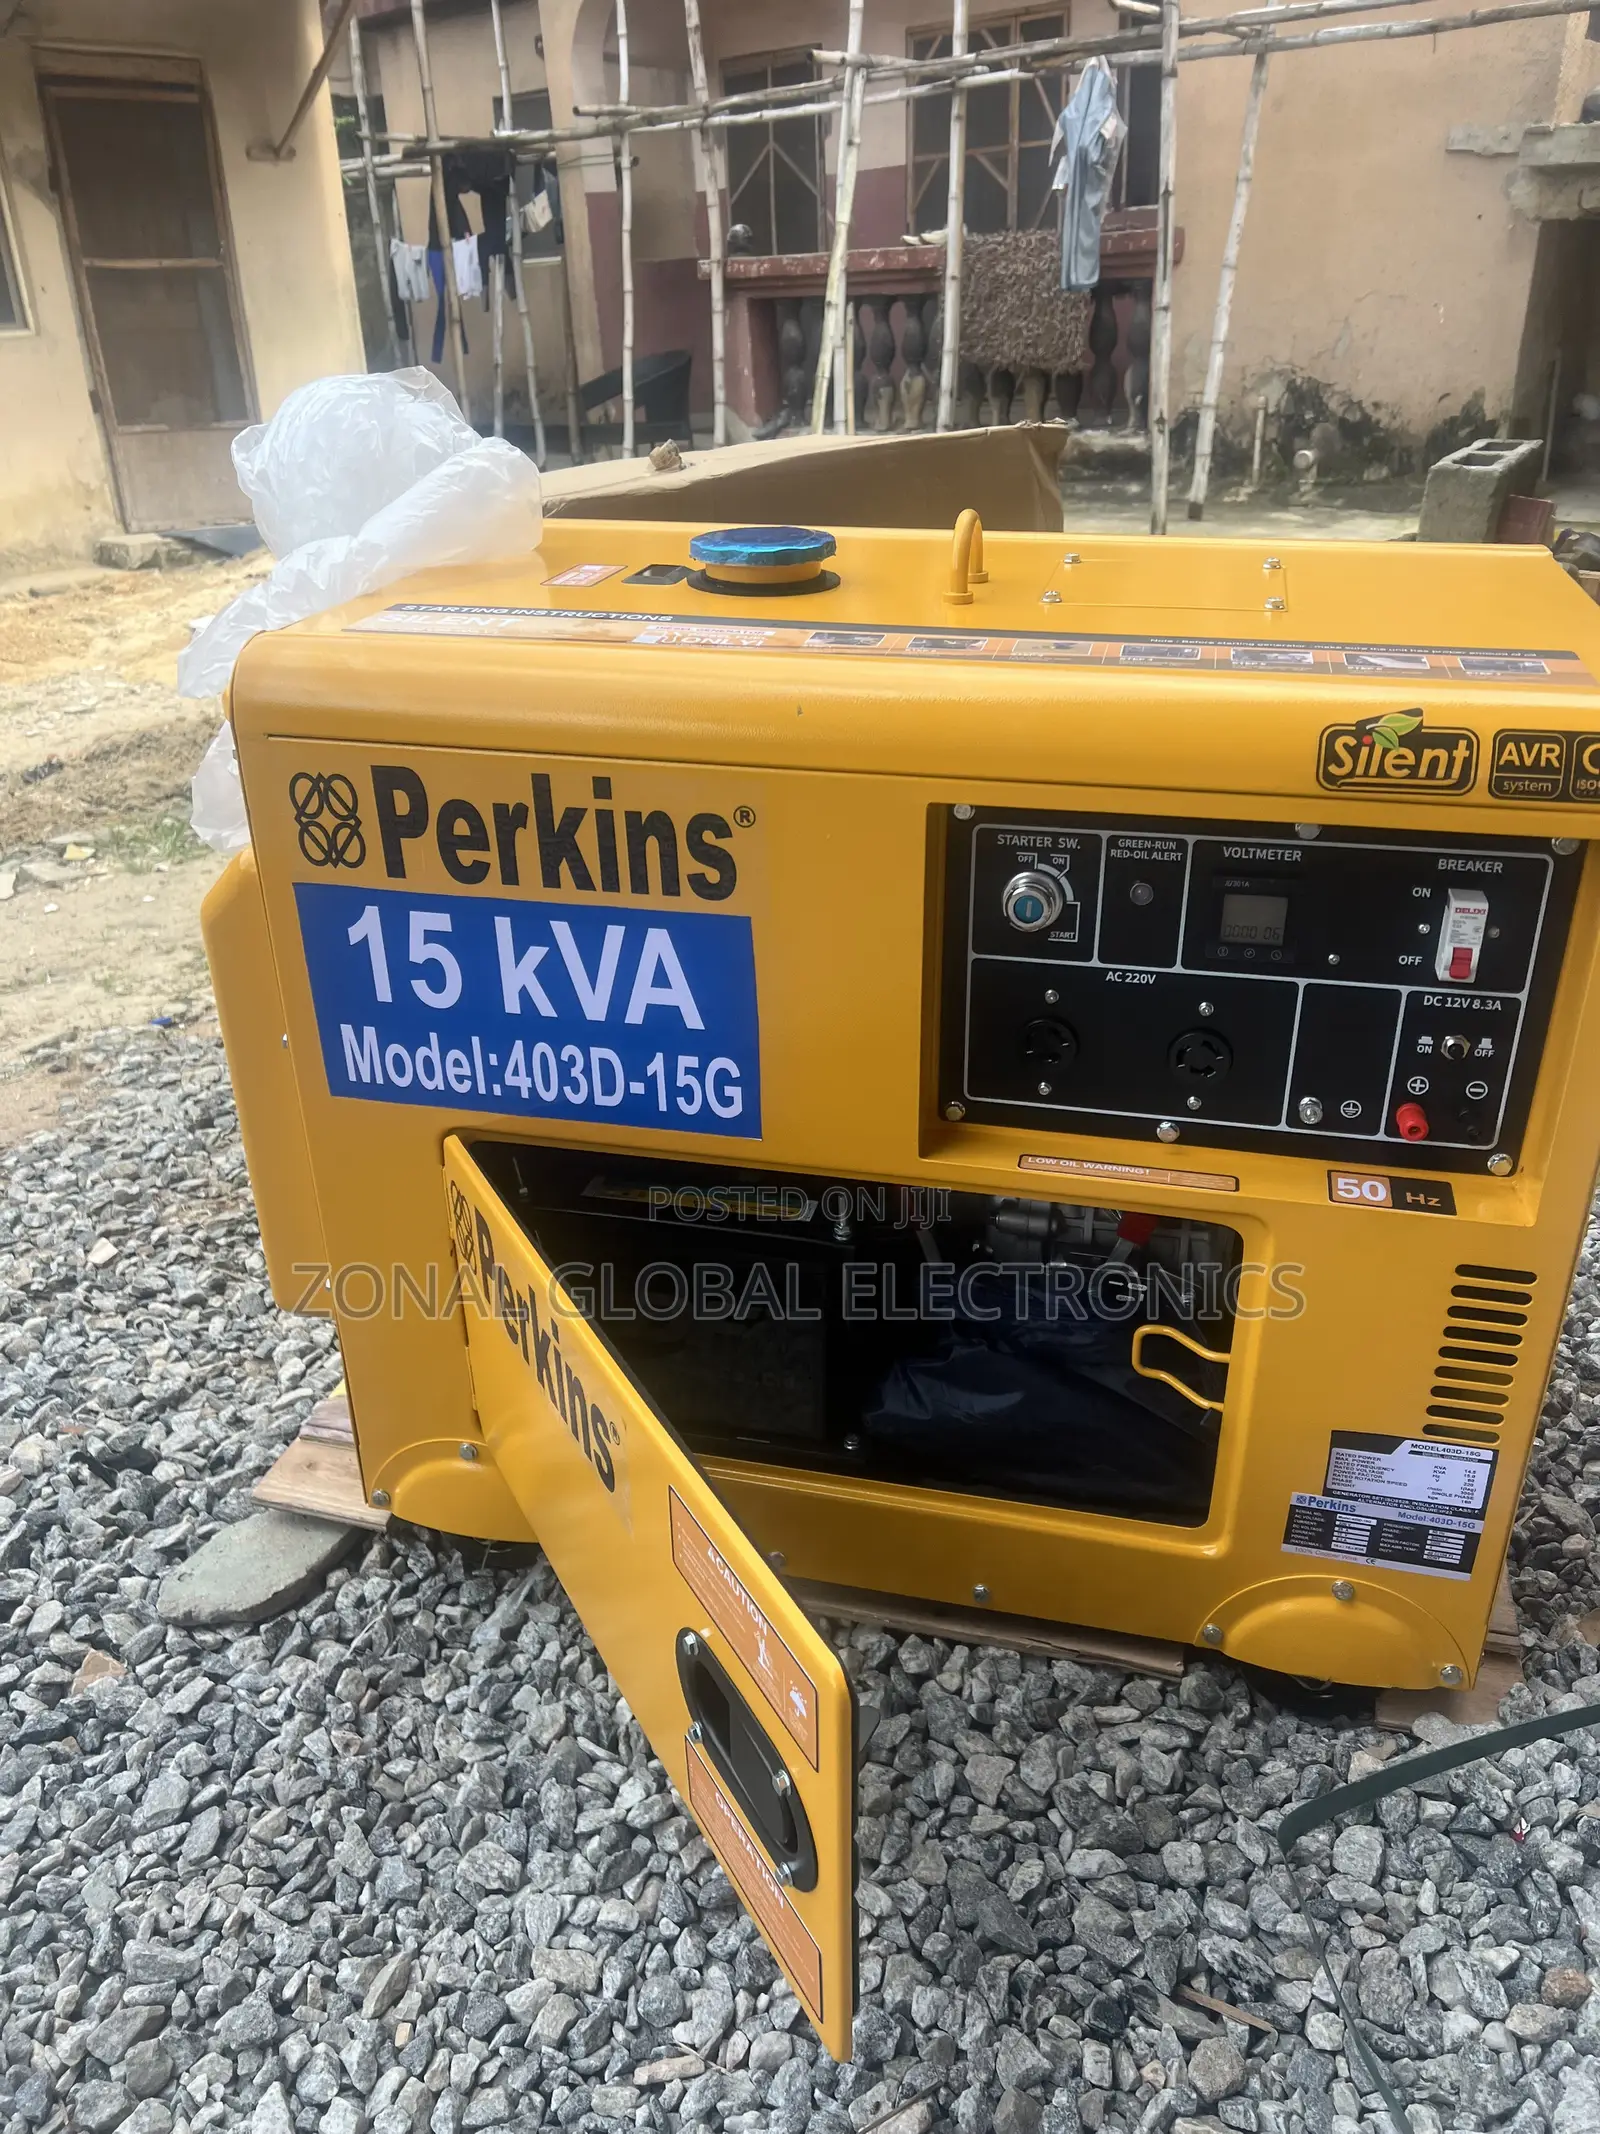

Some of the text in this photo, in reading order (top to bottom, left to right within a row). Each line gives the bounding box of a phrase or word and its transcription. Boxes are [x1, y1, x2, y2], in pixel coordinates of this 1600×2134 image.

[378, 613, 524, 628] SILENT
[401, 605, 674, 621] STARTING INSTRUCTIONS
[1327, 734, 1470, 779] Silent
[1498, 742, 1561, 768] AVR
[1503, 779, 1552, 793] system
[997, 834, 1081, 849] STARTER SW.
[1118, 839, 1176, 850] GREEN-RUN
[1018, 855, 1034, 863] OFF
[1052, 857, 1065, 865] ON
[1110, 850, 1183, 861] RED-OIL ALERT
[1223, 846, 1302, 861] VOLTMETER
[1437, 858, 1503, 873] BREAKER
[1412, 886, 1431, 898] ON
[1050, 931, 1075, 939] START
[347, 905, 705, 1030] 15 kVA
[1398, 955, 1422, 966] OFF
[1105, 971, 1156, 985] AC 220V
[1423, 995, 1502, 1011] DC 12V 8.3A
[1416, 1045, 1433, 1054] ON
[1474, 1048, 1495, 1058] OFF
[340, 1023, 743, 1118] Model:403D-15G
[1028, 1155, 1058, 1166] LOW
[1059, 1159, 1081, 1169] OIL
[1082, 1162, 1150, 1175] WARNING!
[1336, 1178, 1441, 1207] 50 Hz
[1356, 1463, 1394, 1471] FREQUENCY
[1307, 1496, 1357, 1512] Perkins
[1397, 1511, 1475, 1529] Model:403D-15G
[715, 1556, 767, 1636] CAUTION
[714, 1791, 784, 1909] OPERATION
